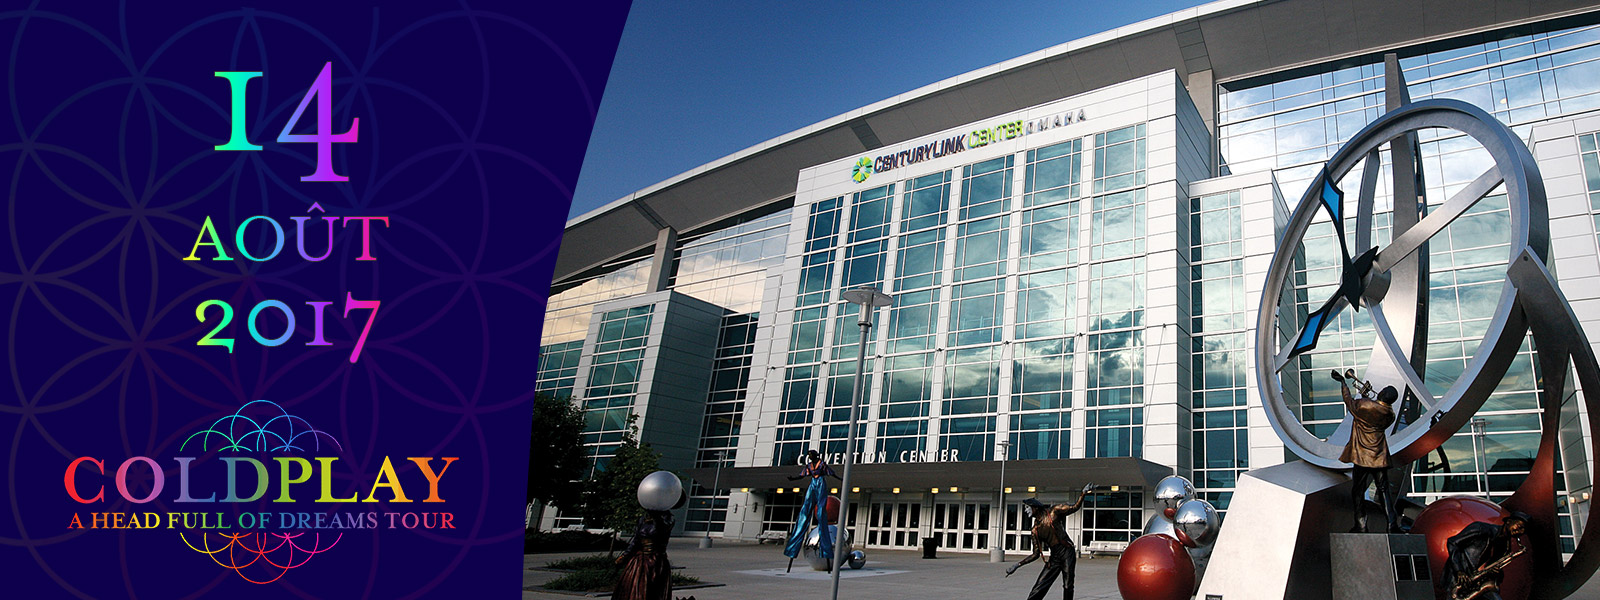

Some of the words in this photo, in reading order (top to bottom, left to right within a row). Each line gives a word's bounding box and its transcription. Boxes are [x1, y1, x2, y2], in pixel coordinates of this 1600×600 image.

[873, 133, 967, 174] CENTURYLINK
[968, 119, 1024, 149] CENTER
[1025, 109, 1087, 135] OMAHA
[797, 450, 887, 466] CVENTION
